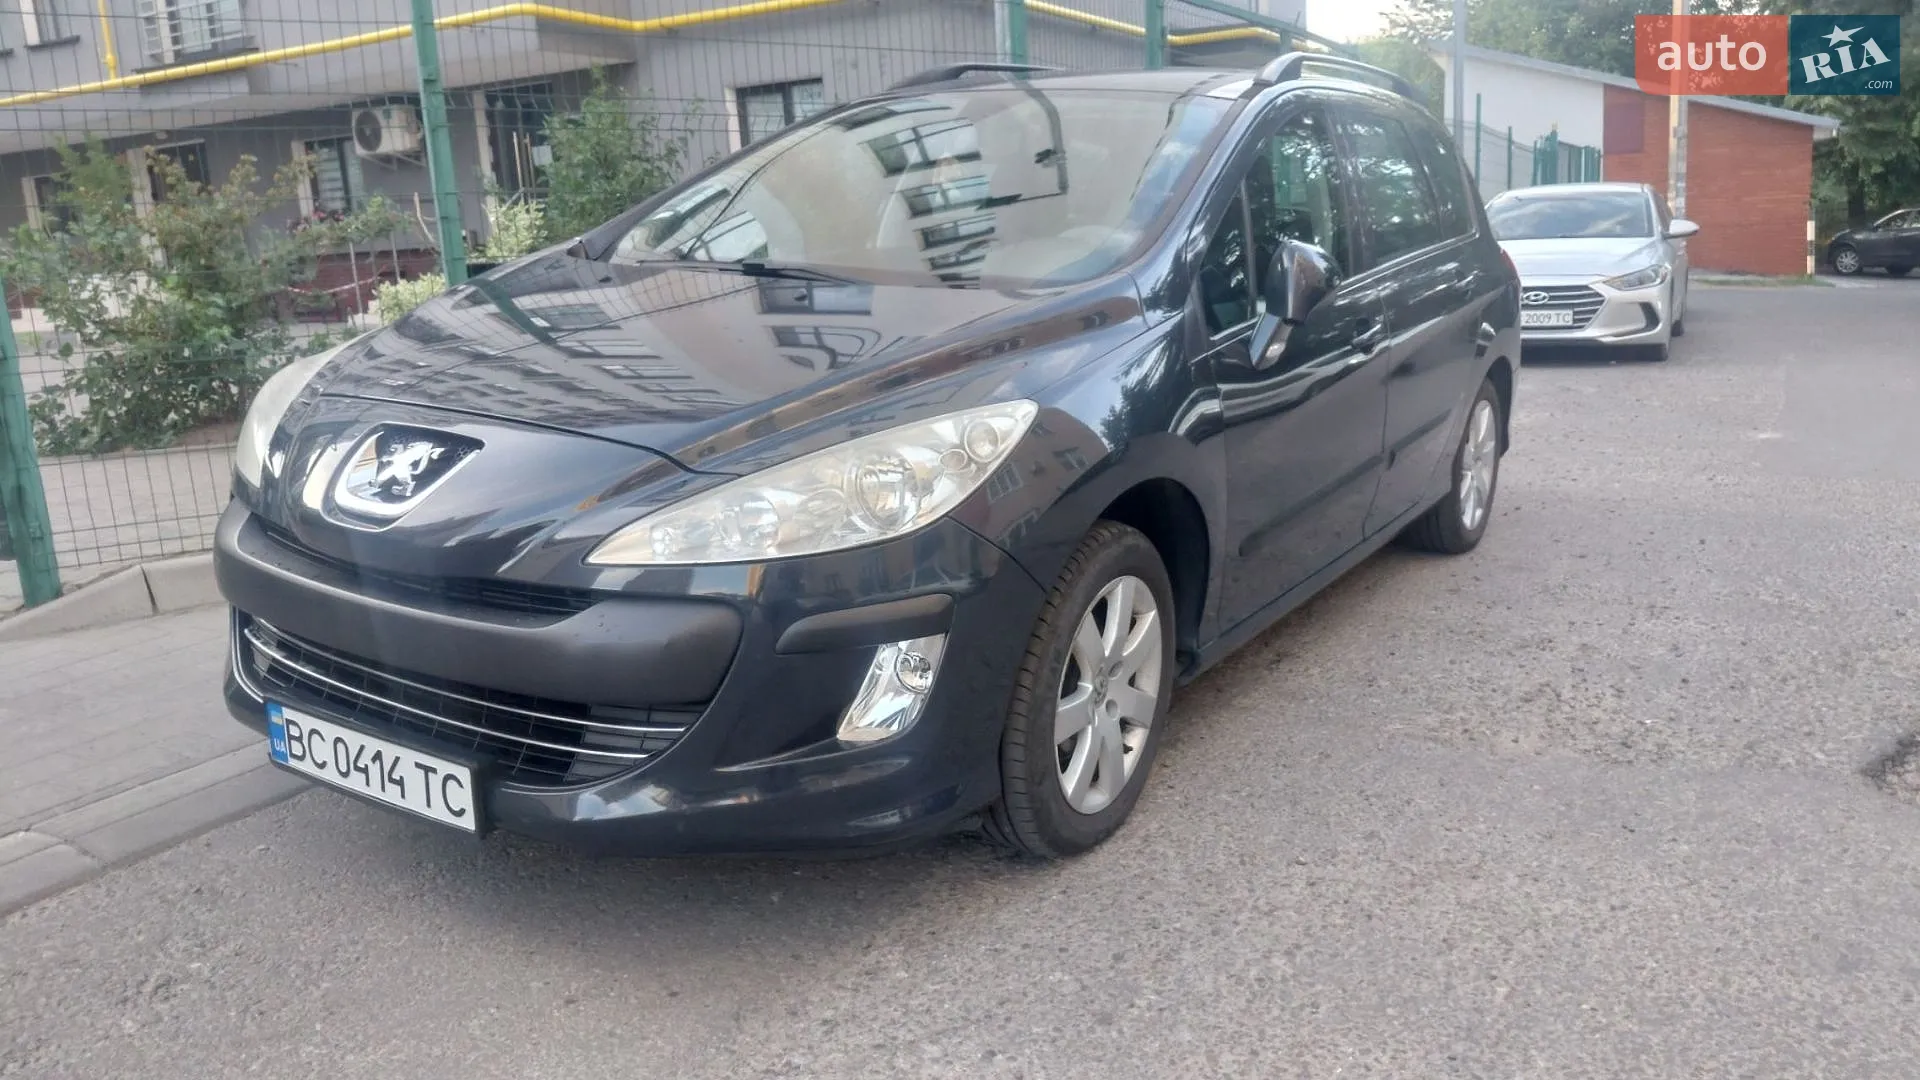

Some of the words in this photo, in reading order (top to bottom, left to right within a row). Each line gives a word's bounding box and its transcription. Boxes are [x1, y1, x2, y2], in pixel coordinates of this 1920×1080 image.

[1524, 313, 1552, 324] 2009
[1554, 313, 1570, 324] TC
[274, 738, 287, 754] UA
[285, 718, 327, 770] BC
[333, 736, 405, 800] 0414
[414, 761, 466, 817] TC
